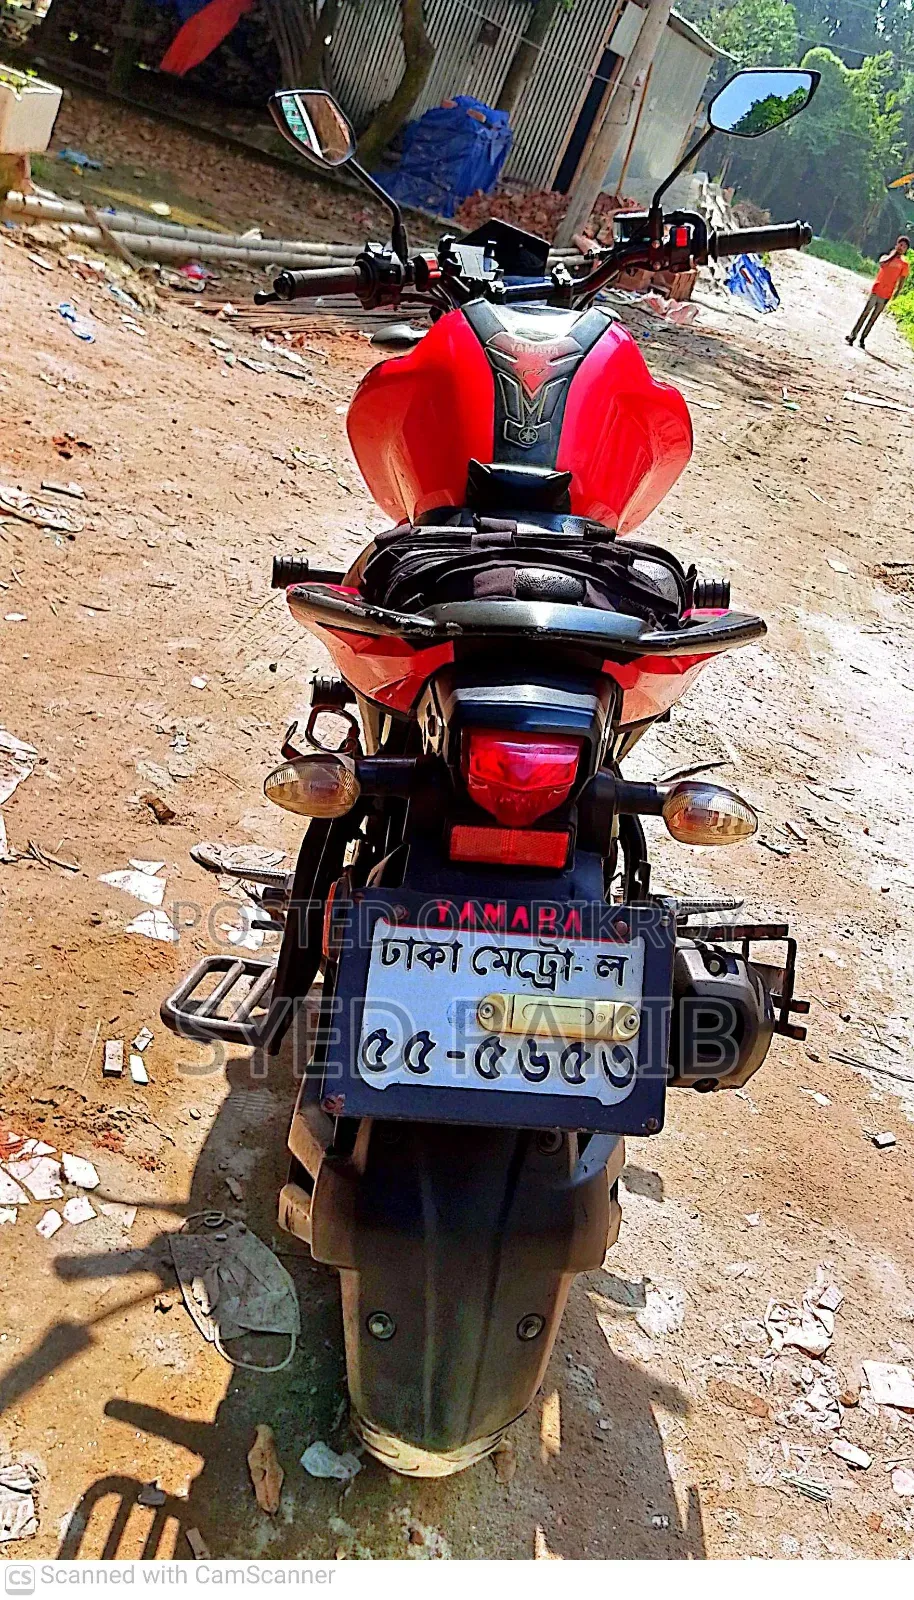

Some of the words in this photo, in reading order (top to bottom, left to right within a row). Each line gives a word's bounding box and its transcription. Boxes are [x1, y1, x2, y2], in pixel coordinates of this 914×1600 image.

[510, 343, 560, 355] YAMAHA
[380, 937, 463, 973] ঢাকা
[596, 954, 629, 986] ল
